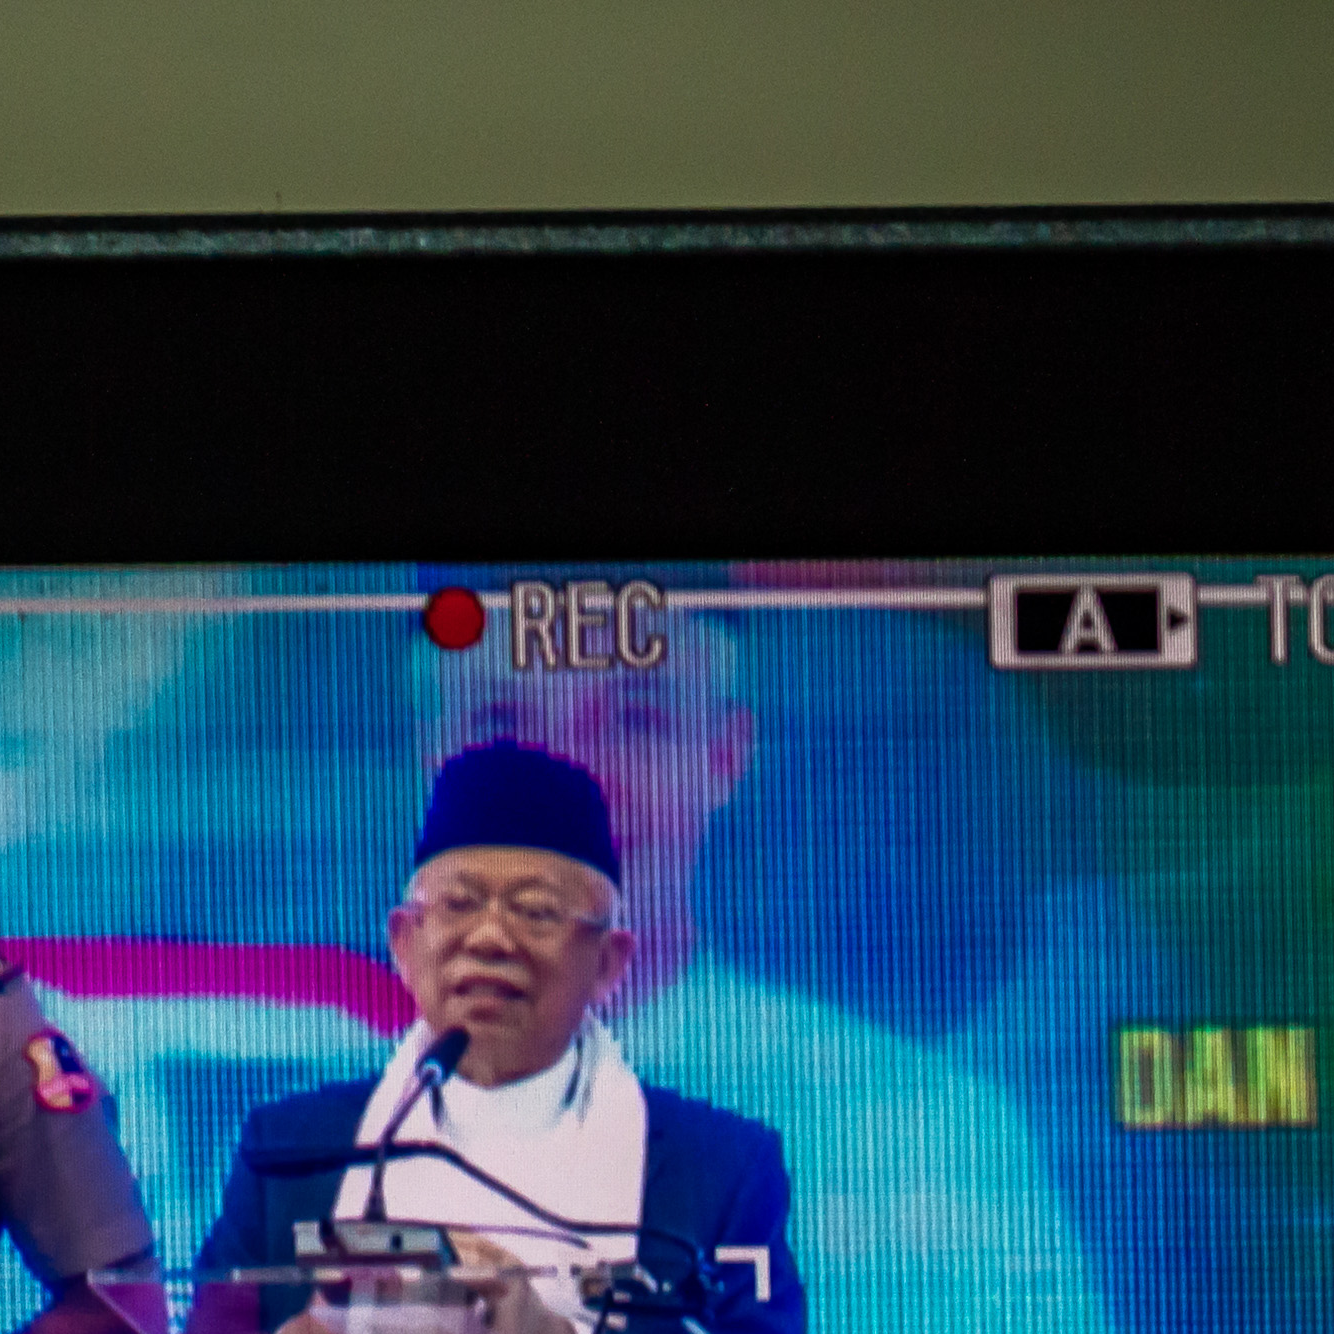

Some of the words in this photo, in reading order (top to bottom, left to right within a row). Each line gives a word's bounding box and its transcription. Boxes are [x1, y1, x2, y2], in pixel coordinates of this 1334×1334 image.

[511, 580, 666, 671] REC
[1056, 585, 1119, 653] A
[1116, 1026, 1318, 1128] DAN
